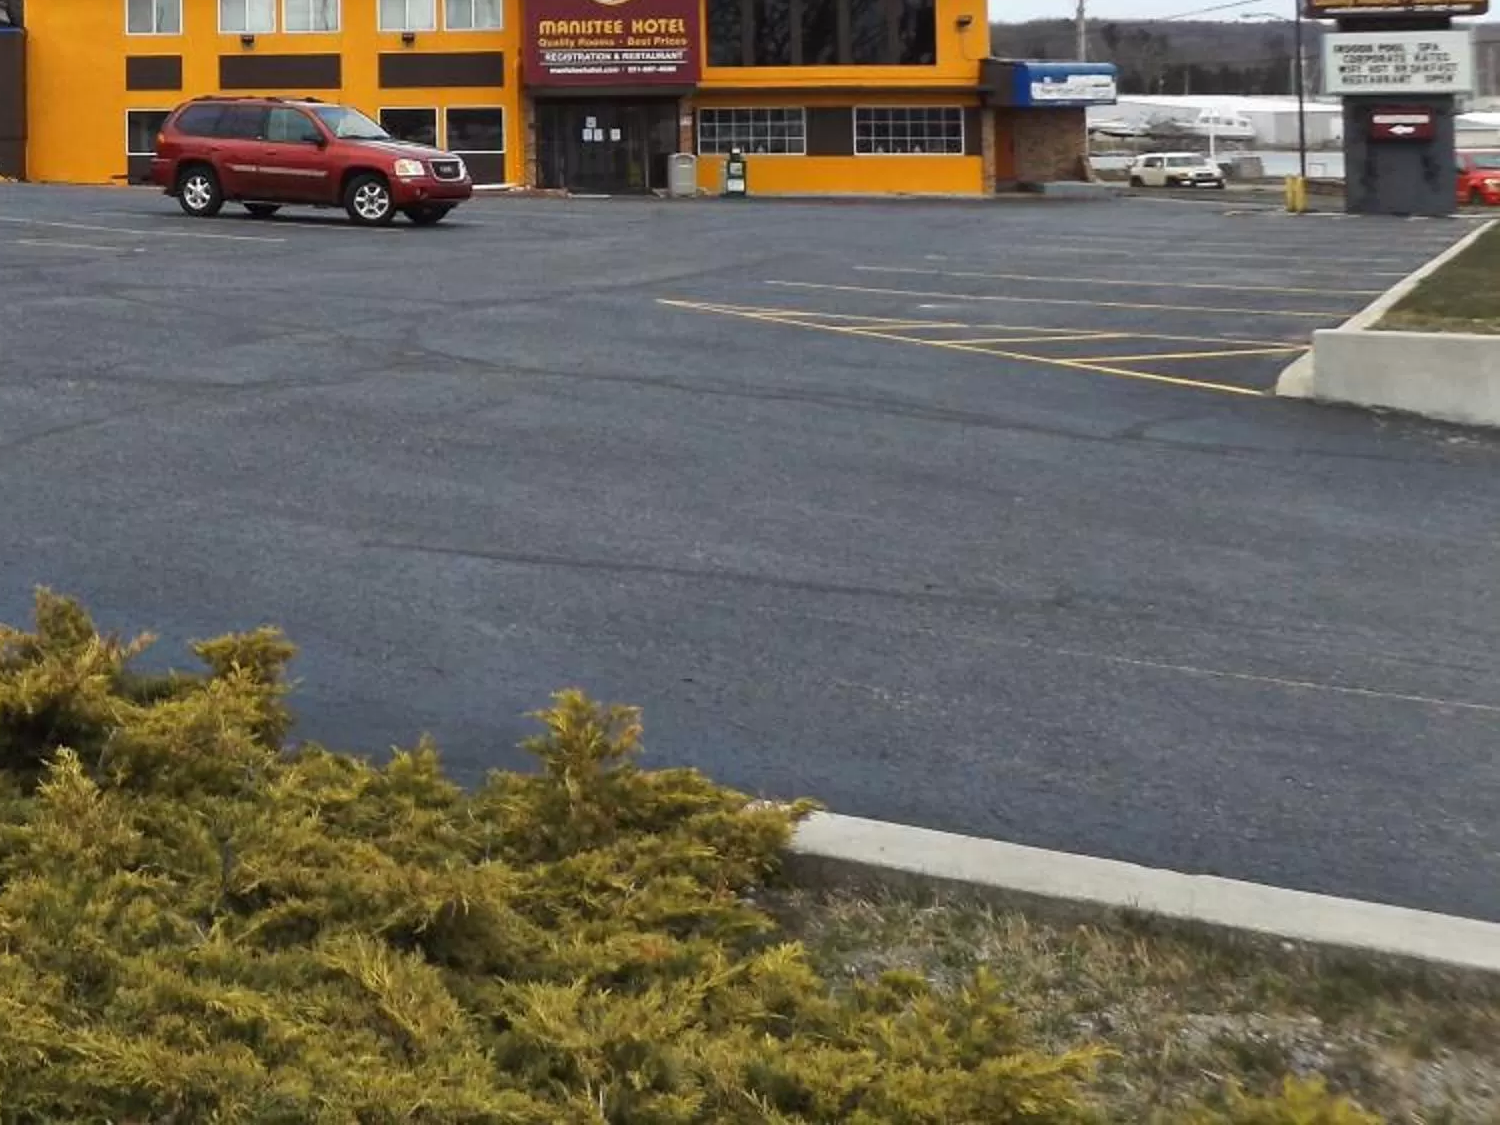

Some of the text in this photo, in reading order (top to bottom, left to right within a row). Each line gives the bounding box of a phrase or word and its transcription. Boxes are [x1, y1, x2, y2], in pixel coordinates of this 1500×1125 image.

[539, 18, 685, 35] MANISTEE HOTEL
[538, 36, 688, 49] Quality Rooms Best Prices
[544, 51, 683, 62] REGISTRATION & RESTAURANT
